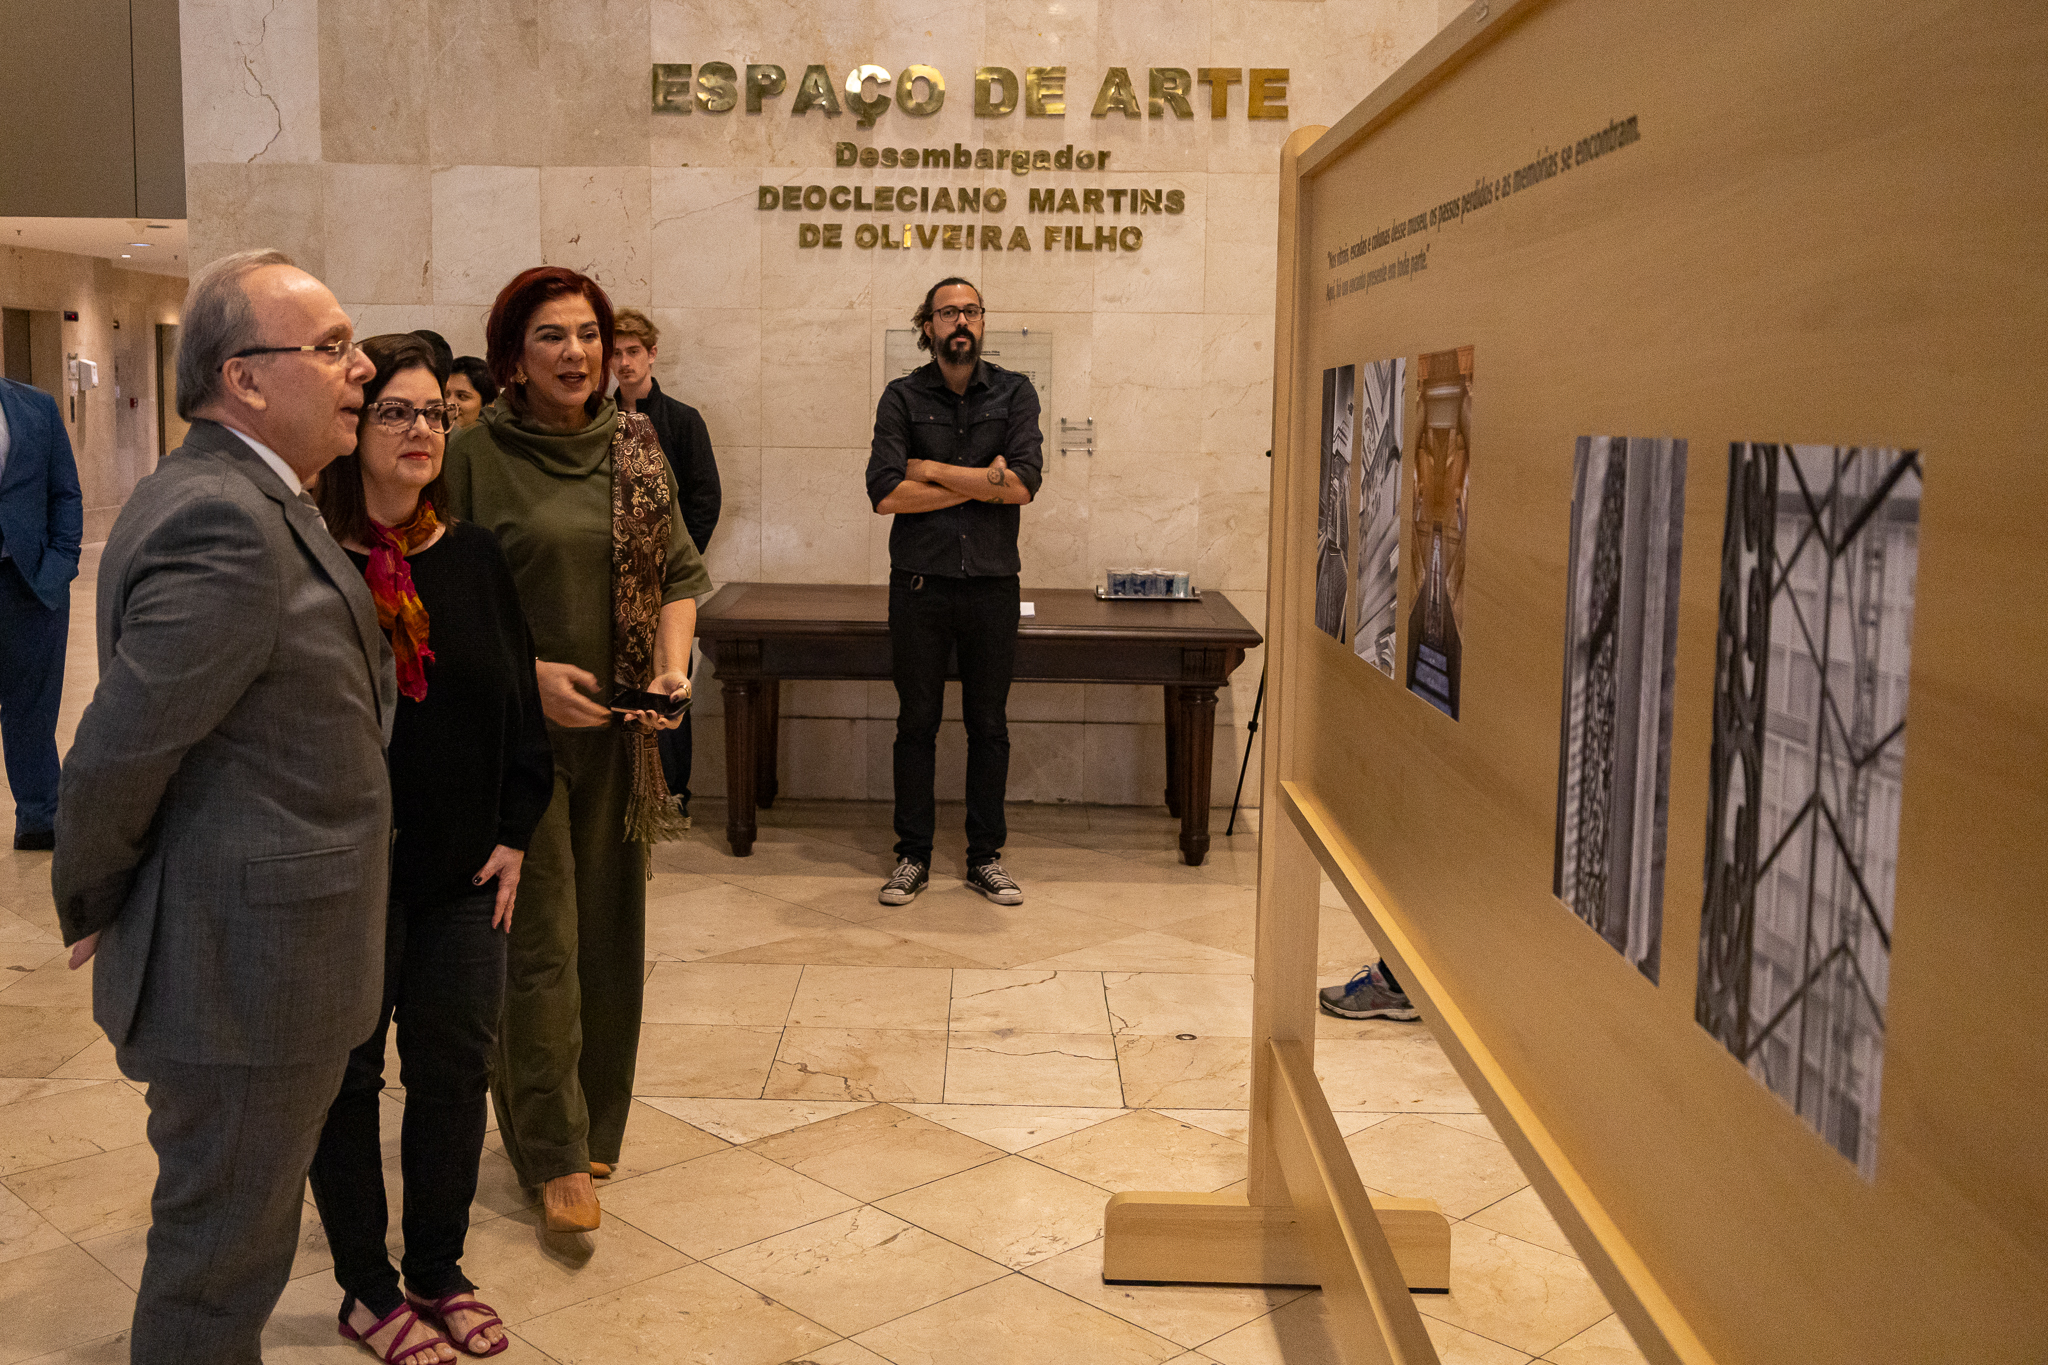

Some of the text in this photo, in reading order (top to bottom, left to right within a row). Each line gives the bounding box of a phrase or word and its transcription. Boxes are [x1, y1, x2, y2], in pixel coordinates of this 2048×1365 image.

[651, 61, 1290, 128] ESPAÇO DE ARTE
[835, 141, 1111, 174] Desembargador
[758, 184, 1187, 215] DEOCLECIANO MARTINS
[1350, 235, 1367, 260] escadas
[1372, 226, 1391, 251] colunas
[1391, 219, 1407, 243] desse
[1429, 207, 1438, 227] os
[1438, 197, 1461, 232] passos
[1461, 176, 1494, 224] perdidos
[1495, 179, 1501, 201] e
[1501, 173, 1512, 198] as
[1513, 146, 1558, 193] memórias
[1560, 145, 1573, 173] se
[799, 222, 1143, 252] DE OLIVEIRA FILHO
